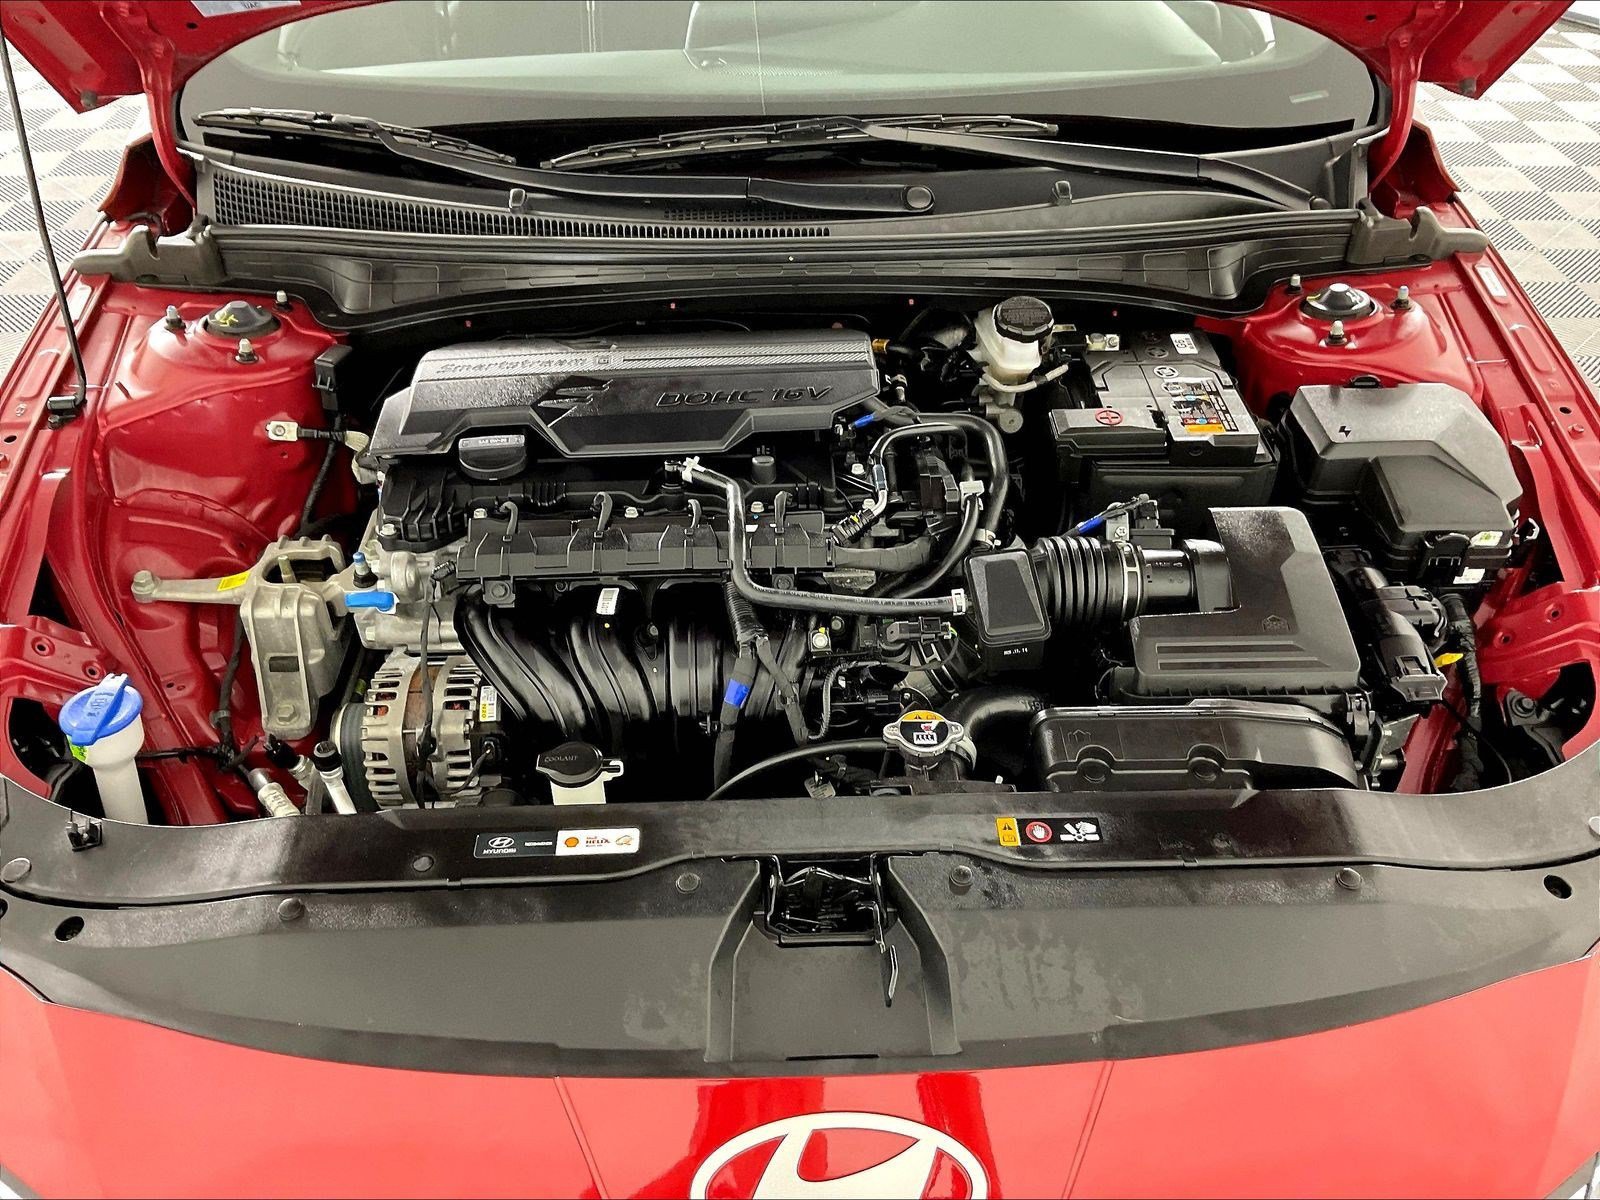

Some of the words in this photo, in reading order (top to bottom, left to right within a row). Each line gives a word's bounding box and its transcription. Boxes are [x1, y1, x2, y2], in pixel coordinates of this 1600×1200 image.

[437, 357, 588, 374] Smartstream
[655, 388, 764, 407] DOHC
[771, 385, 833, 401] 16V
